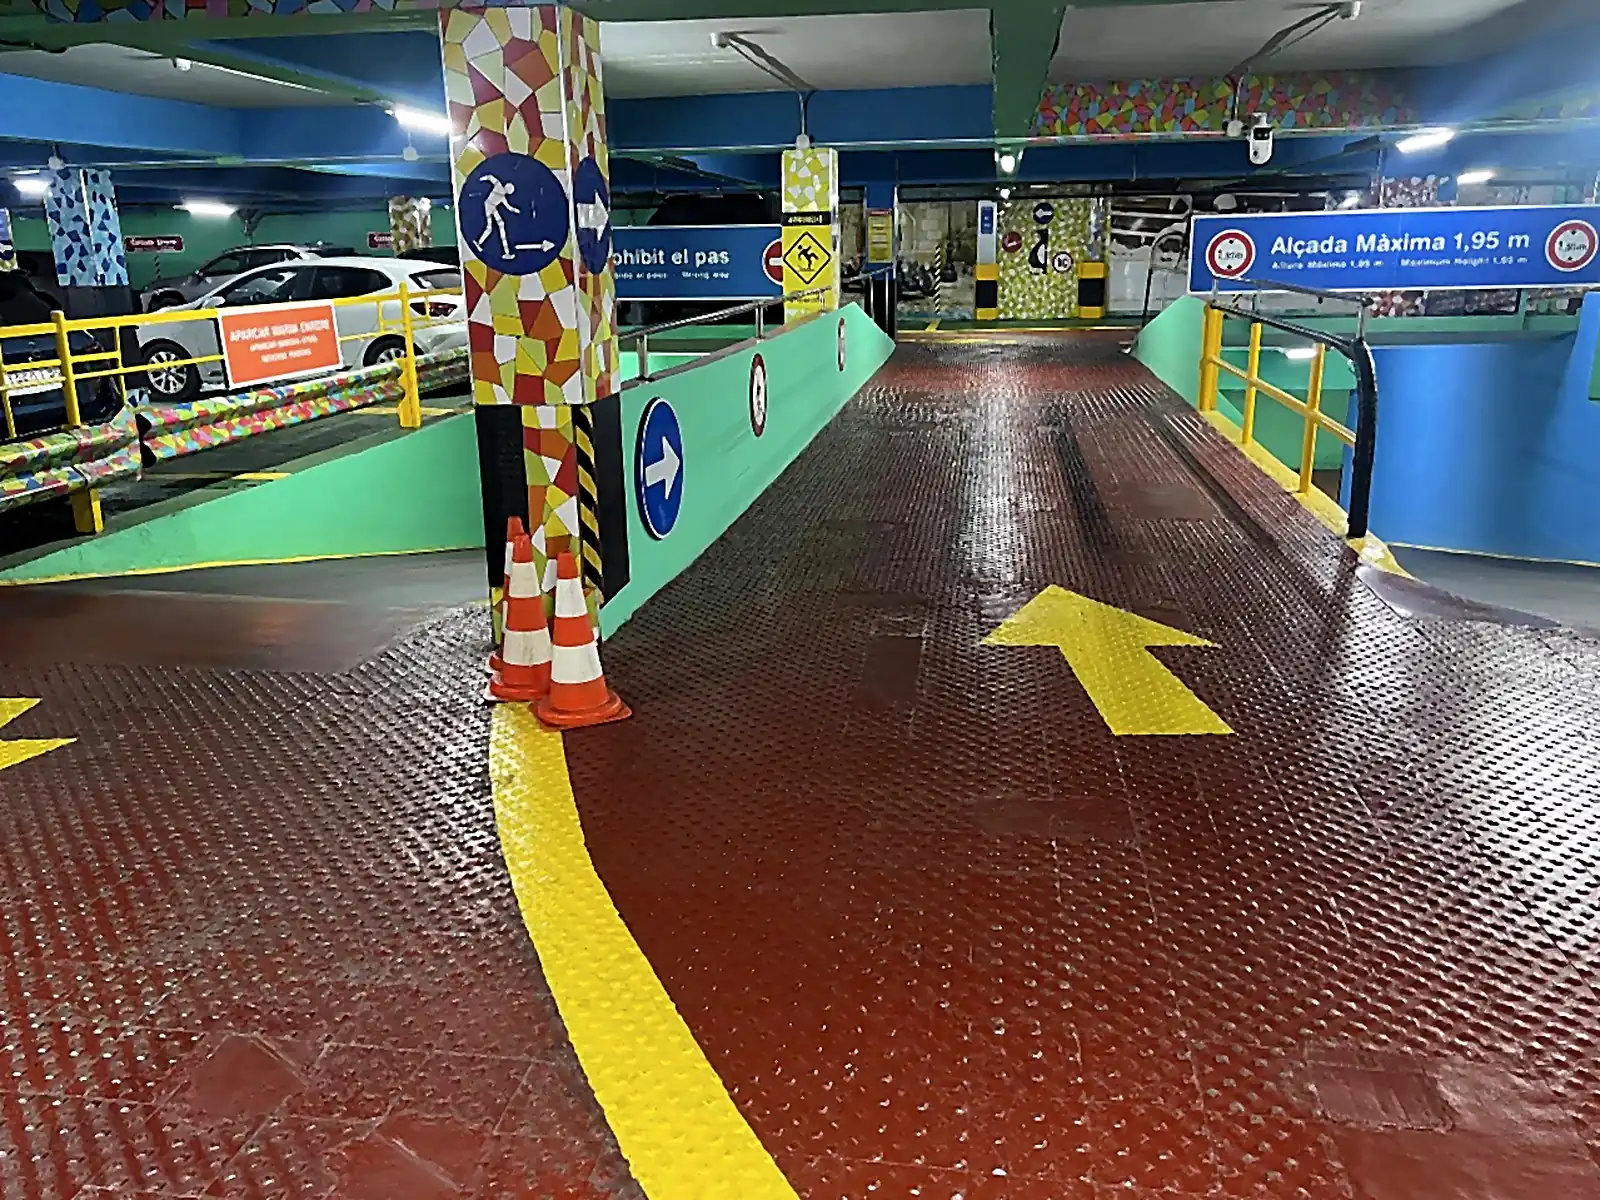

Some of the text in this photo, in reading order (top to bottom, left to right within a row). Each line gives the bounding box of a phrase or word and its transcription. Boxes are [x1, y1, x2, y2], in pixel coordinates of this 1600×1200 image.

[1271, 231, 1529, 258] Alçada Màxima 1,95 m
[671, 248, 688, 265] el
[694, 249, 730, 268] pas
